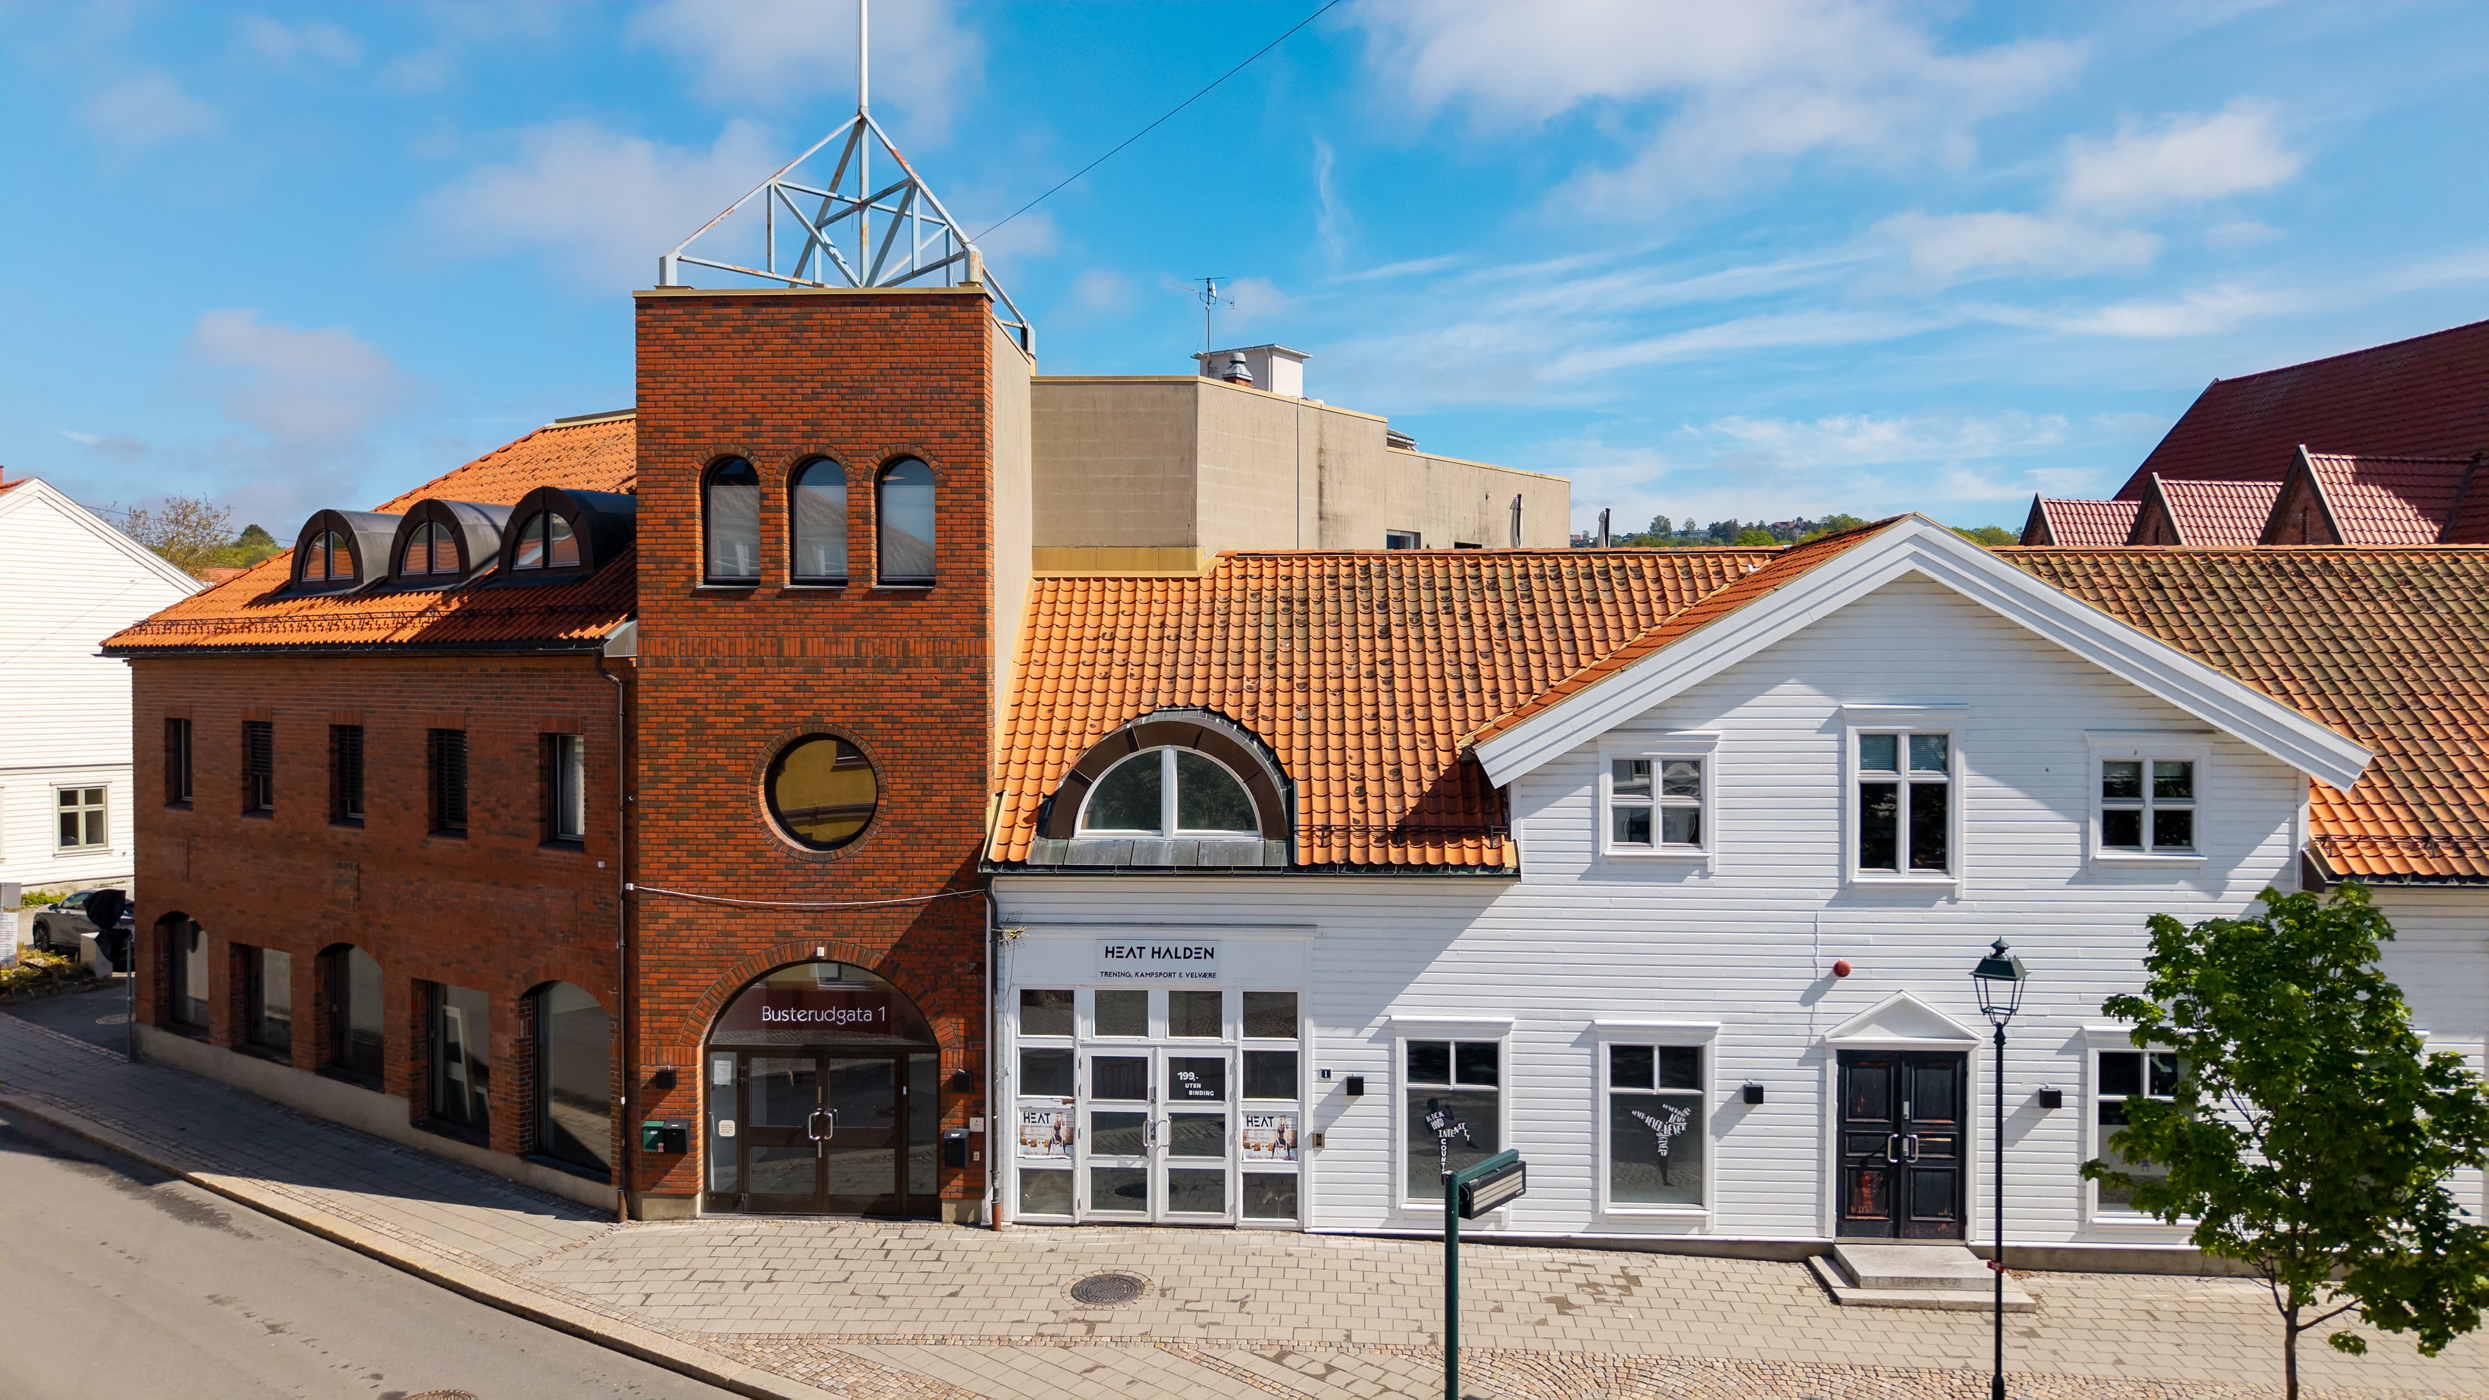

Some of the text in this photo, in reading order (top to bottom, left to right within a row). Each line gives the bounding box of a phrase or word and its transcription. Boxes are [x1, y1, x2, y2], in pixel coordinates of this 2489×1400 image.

[1105, 946, 1215, 960] HEAT HALDEN
[1100, 971, 1133, 979] TRENING,
[1135, 971, 1177, 979] KAMPSPORT
[762, 1005, 886, 1026] Busterudgata 1
[1023, 1111, 1051, 1124] HEAT
[1246, 1115, 1275, 1128] HEAT
